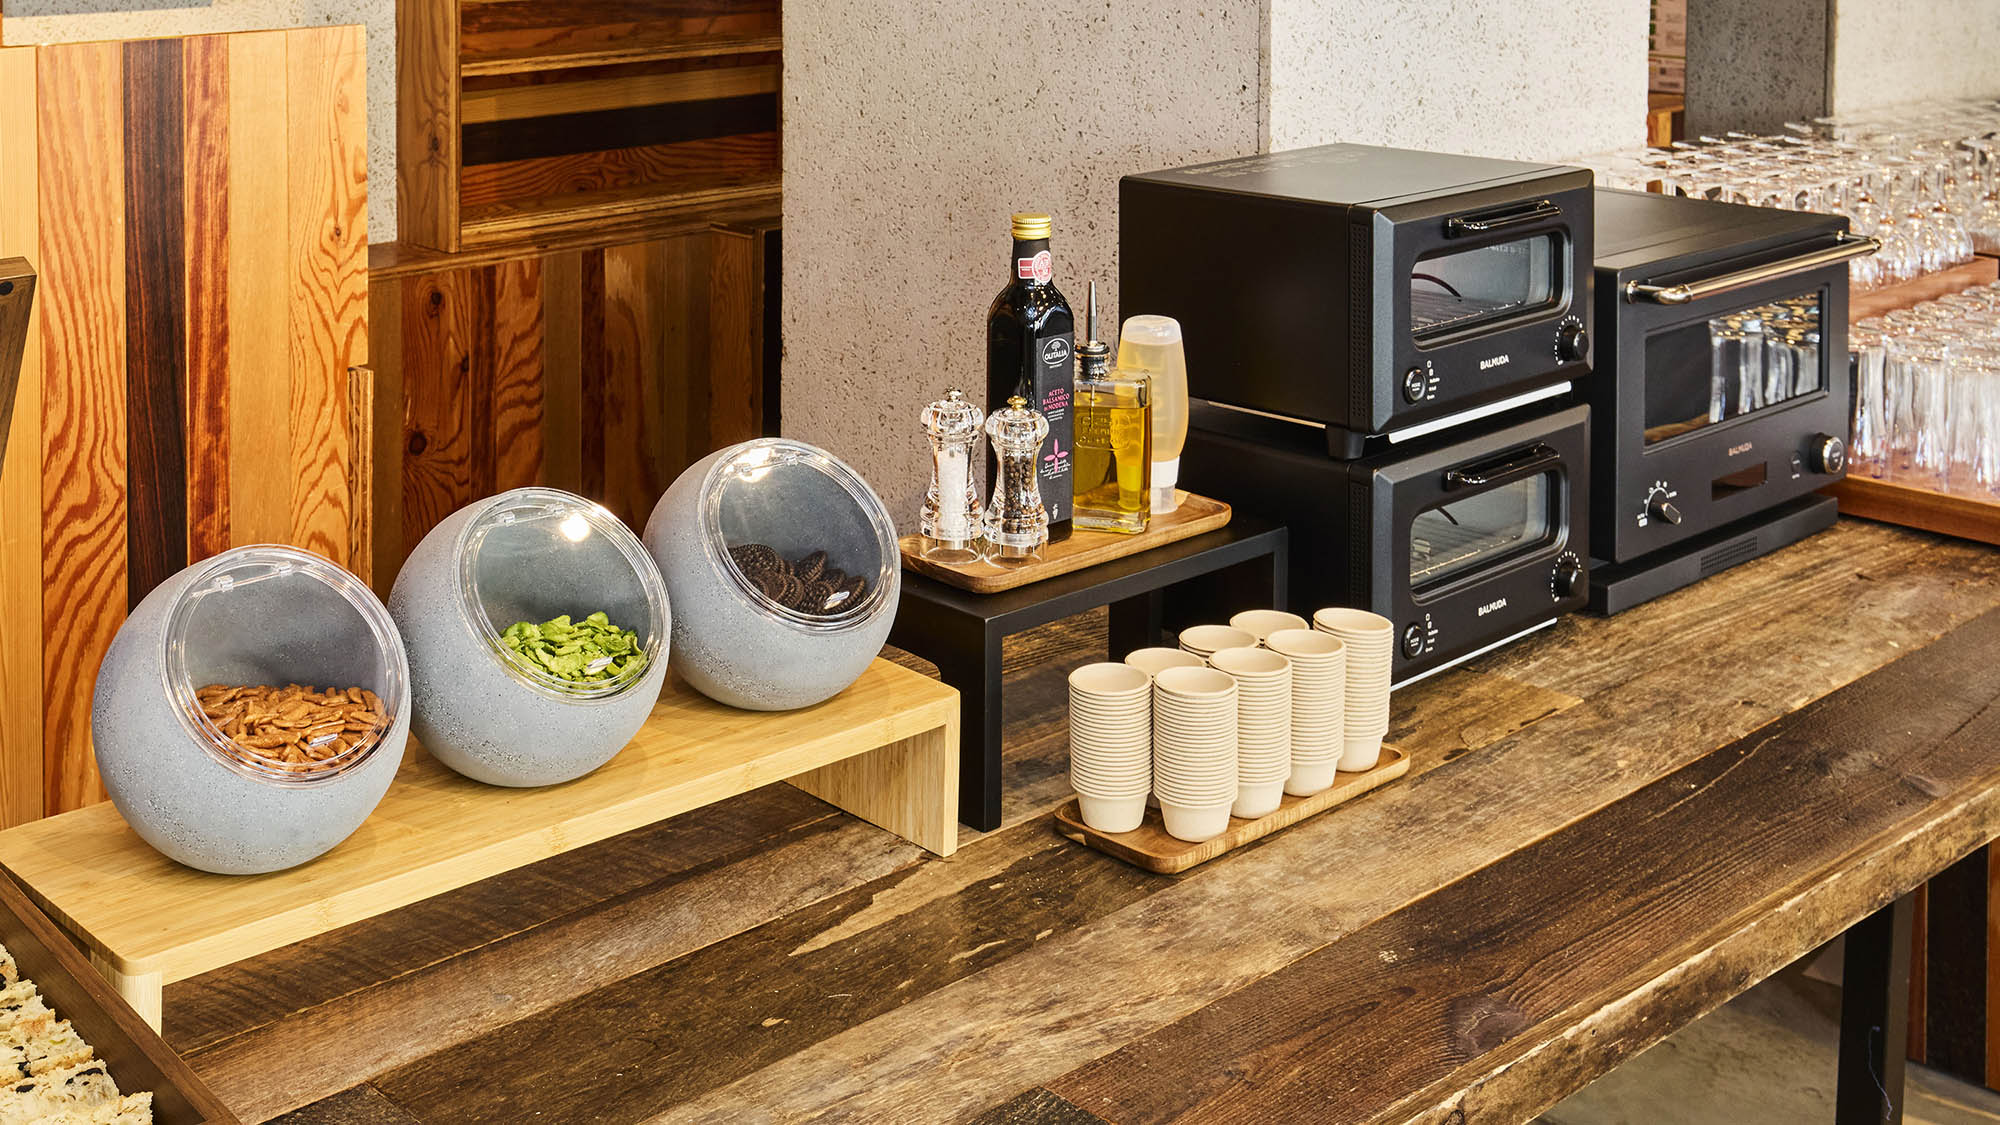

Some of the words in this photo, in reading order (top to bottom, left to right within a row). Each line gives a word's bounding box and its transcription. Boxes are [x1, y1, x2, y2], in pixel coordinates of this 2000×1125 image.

[1044, 350, 1067, 360] OLITALIA
[1480, 355, 1510, 370] BALMUDA
[1048, 388, 1064, 396] ACETO
[1042, 393, 1070, 405] BALSAMICO
[1048, 401, 1069, 410] MODENA
[1728, 442, 1752, 457] BALMUDA
[1478, 598, 1507, 616] BALMUDA
